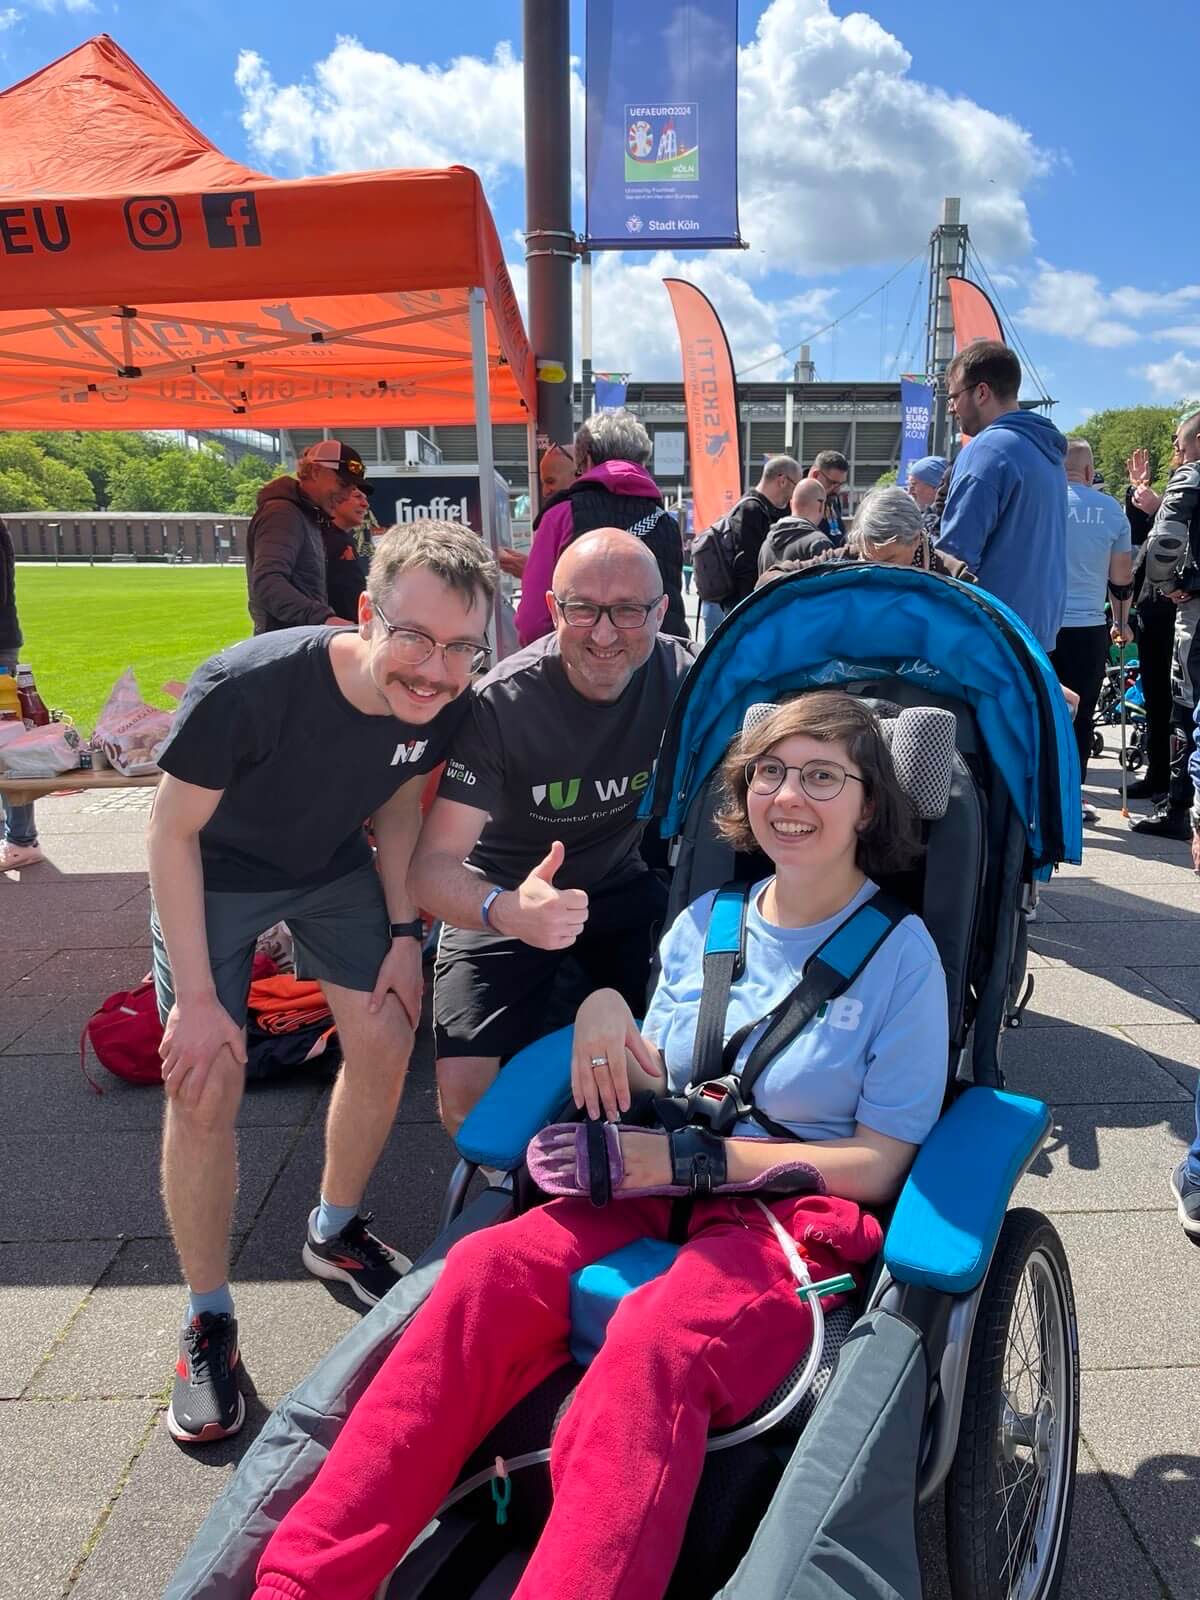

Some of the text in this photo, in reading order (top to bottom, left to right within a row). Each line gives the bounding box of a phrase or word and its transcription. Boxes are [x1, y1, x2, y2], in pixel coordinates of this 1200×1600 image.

[648, 219, 700, 231] Stadt Köln
[905, 406, 929, 415] UEFA
[905, 414, 929, 423] EURO
[905, 422, 929, 431] 2024
[446, 767, 477, 786] welb
